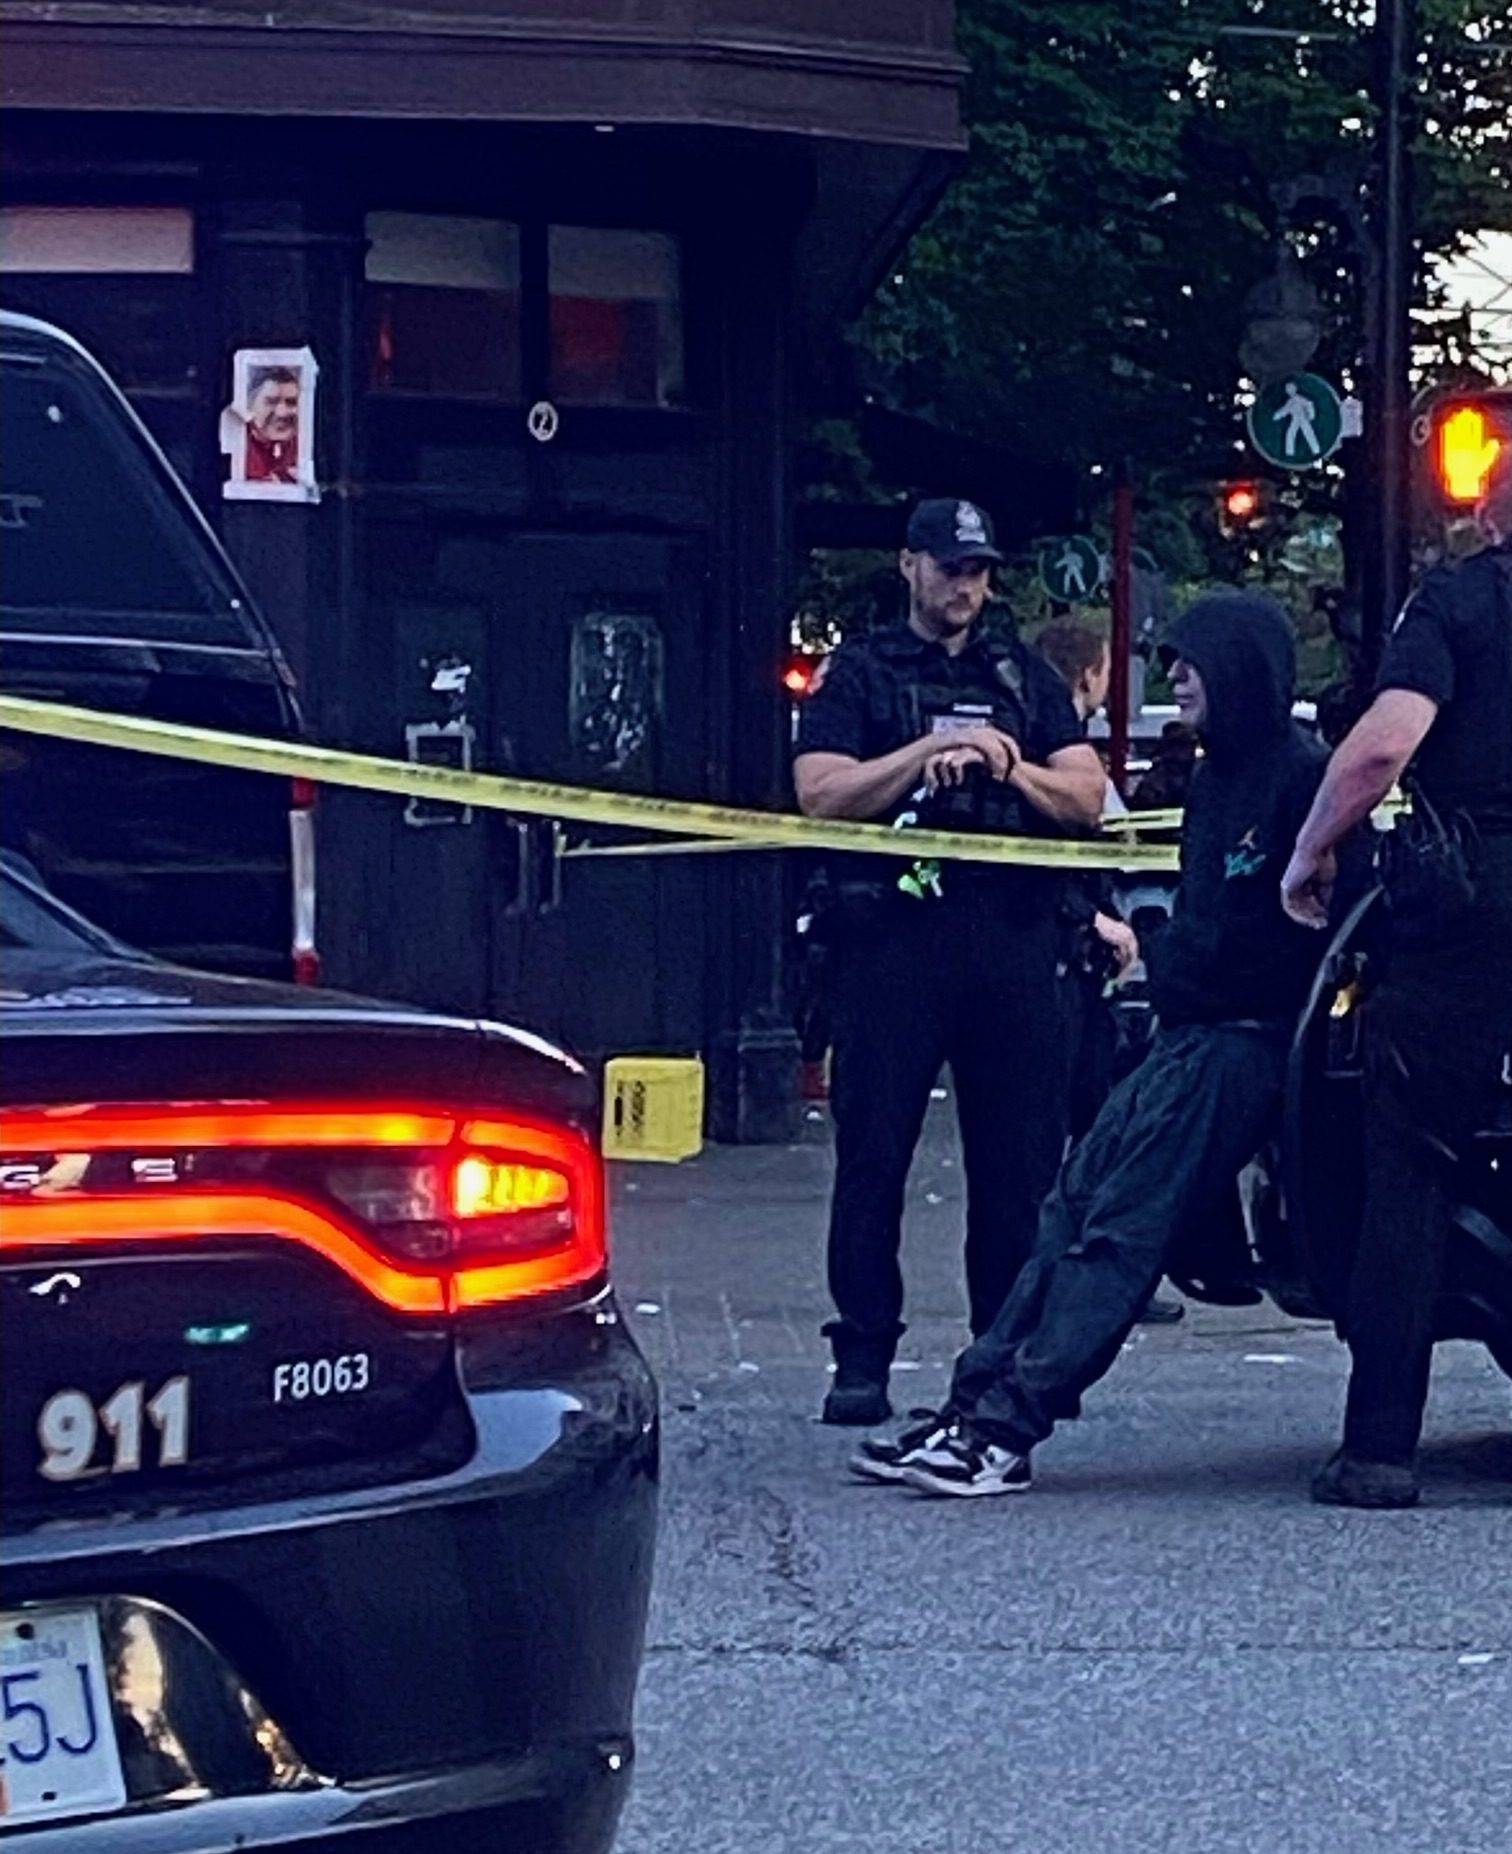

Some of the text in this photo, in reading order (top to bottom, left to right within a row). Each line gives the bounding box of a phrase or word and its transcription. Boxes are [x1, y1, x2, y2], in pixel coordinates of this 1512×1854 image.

[37, 1375, 190, 1482] 911
[274, 1353, 369, 1402] F8063
[0, 1663, 97, 1765] 5J
